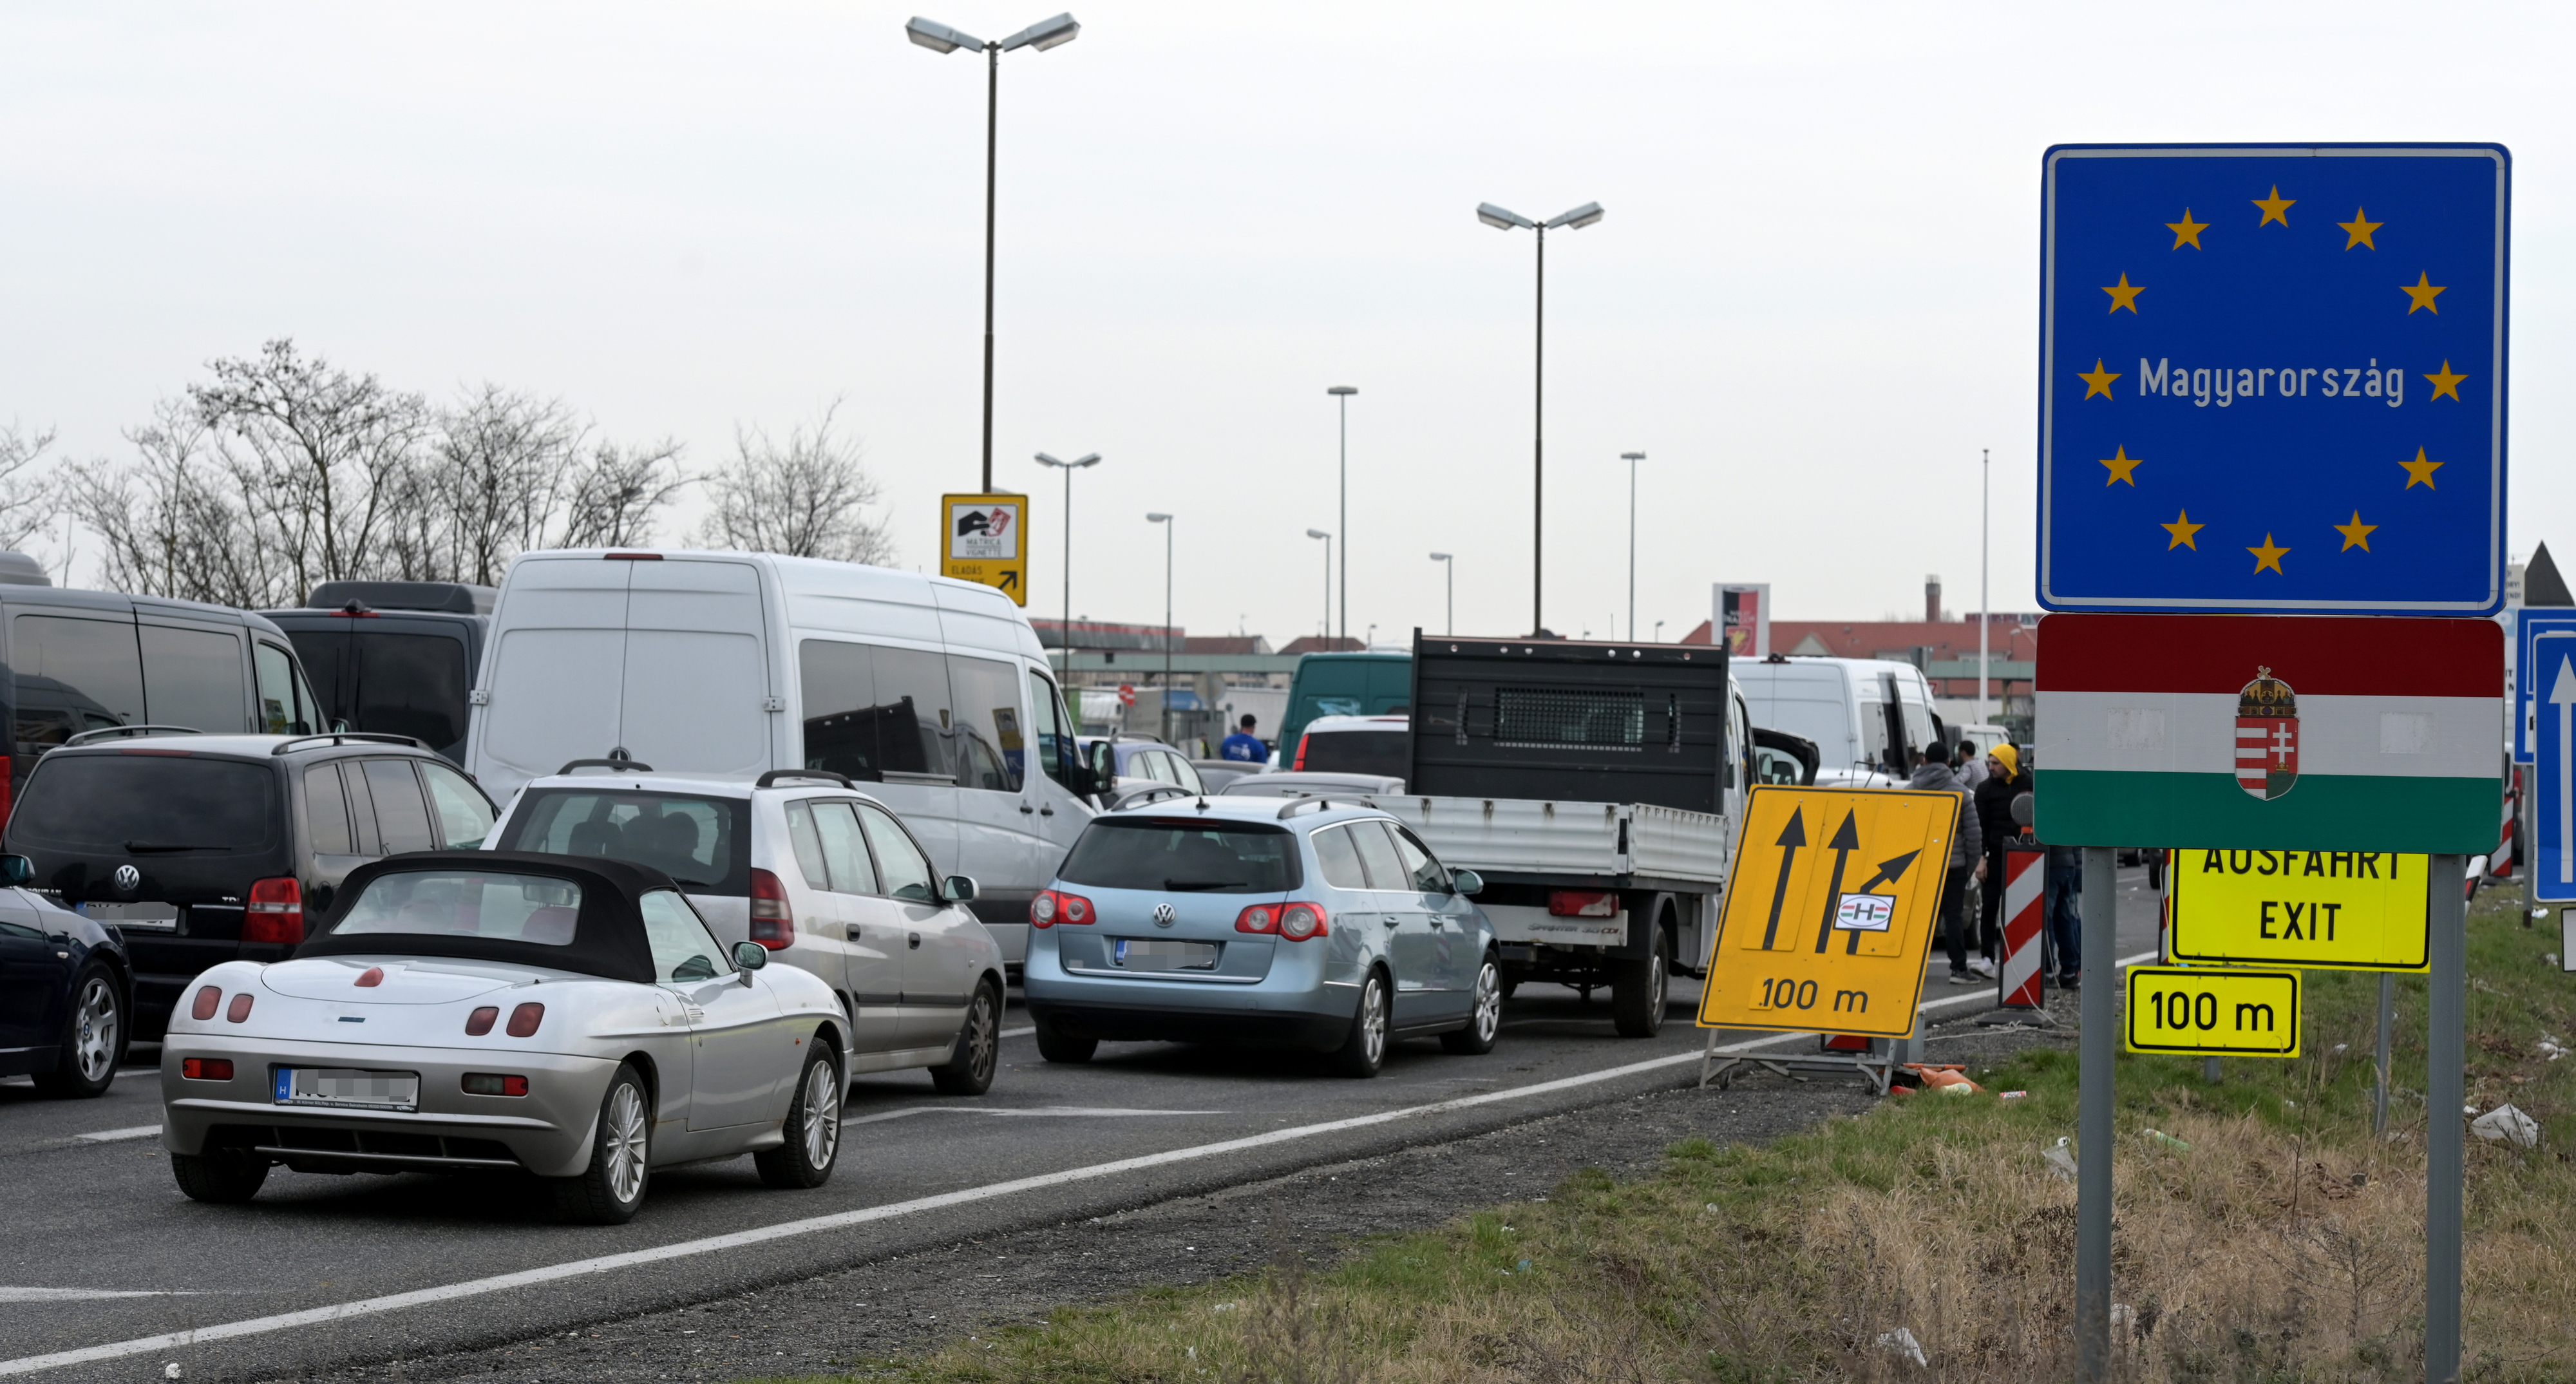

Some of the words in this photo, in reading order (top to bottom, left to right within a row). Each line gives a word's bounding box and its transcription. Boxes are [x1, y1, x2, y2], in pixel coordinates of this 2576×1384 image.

[2140, 357, 2403, 408] Magyarország
[952, 564, 983, 575] ELADÁS
[1853, 903, 1875, 921] H
[2260, 900, 2342, 942] EXIT
[1763, 978, 1818, 1010] 100
[1833, 990, 1868, 1013] m
[2151, 991, 2217, 1030] 100
[2235, 1003, 2274, 1032] m
[279, 1086, 287, 1095] H
